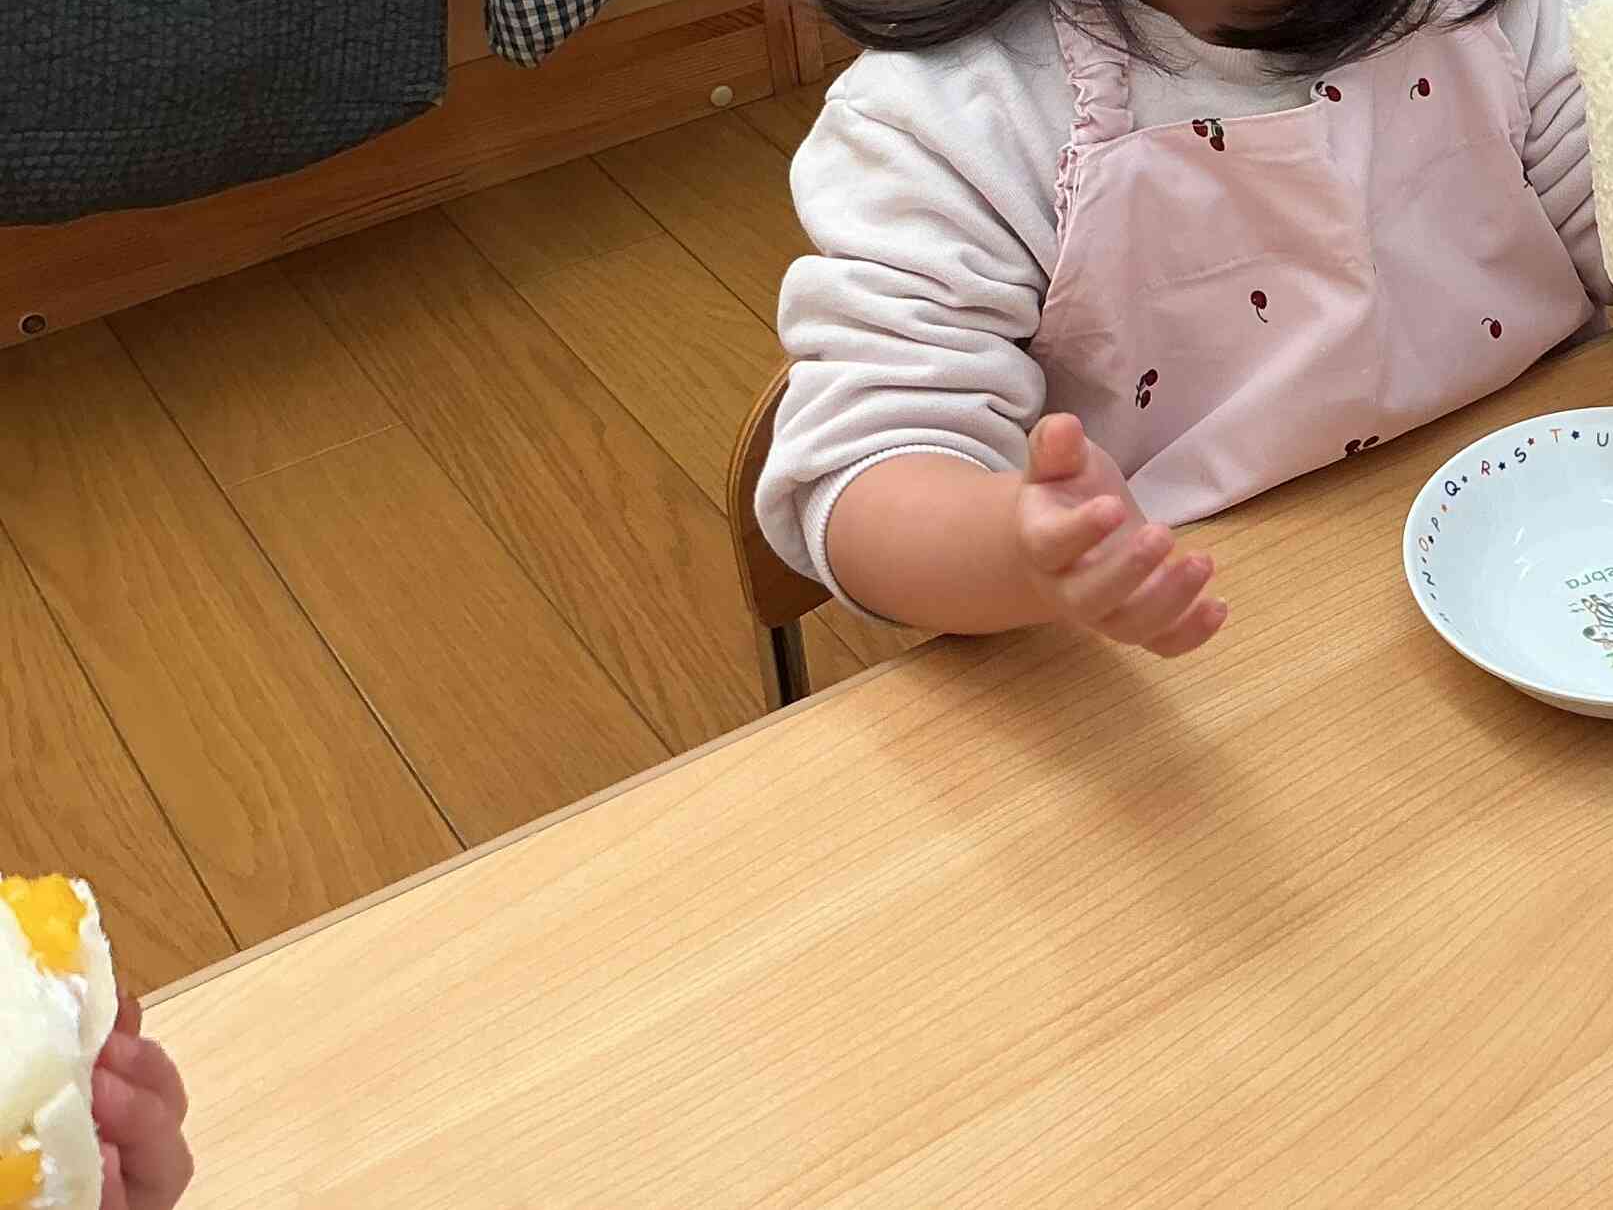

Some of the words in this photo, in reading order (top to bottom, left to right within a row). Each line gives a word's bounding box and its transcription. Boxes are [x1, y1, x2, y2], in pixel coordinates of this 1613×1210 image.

[1431, 517, 1441, 532] P
[1444, 480, 1461, 496] Q
[1480, 460, 1491, 475] R
[1514, 447, 1527, 463] S
[1550, 428, 1562, 443] T
[1596, 432, 1609, 447] U
